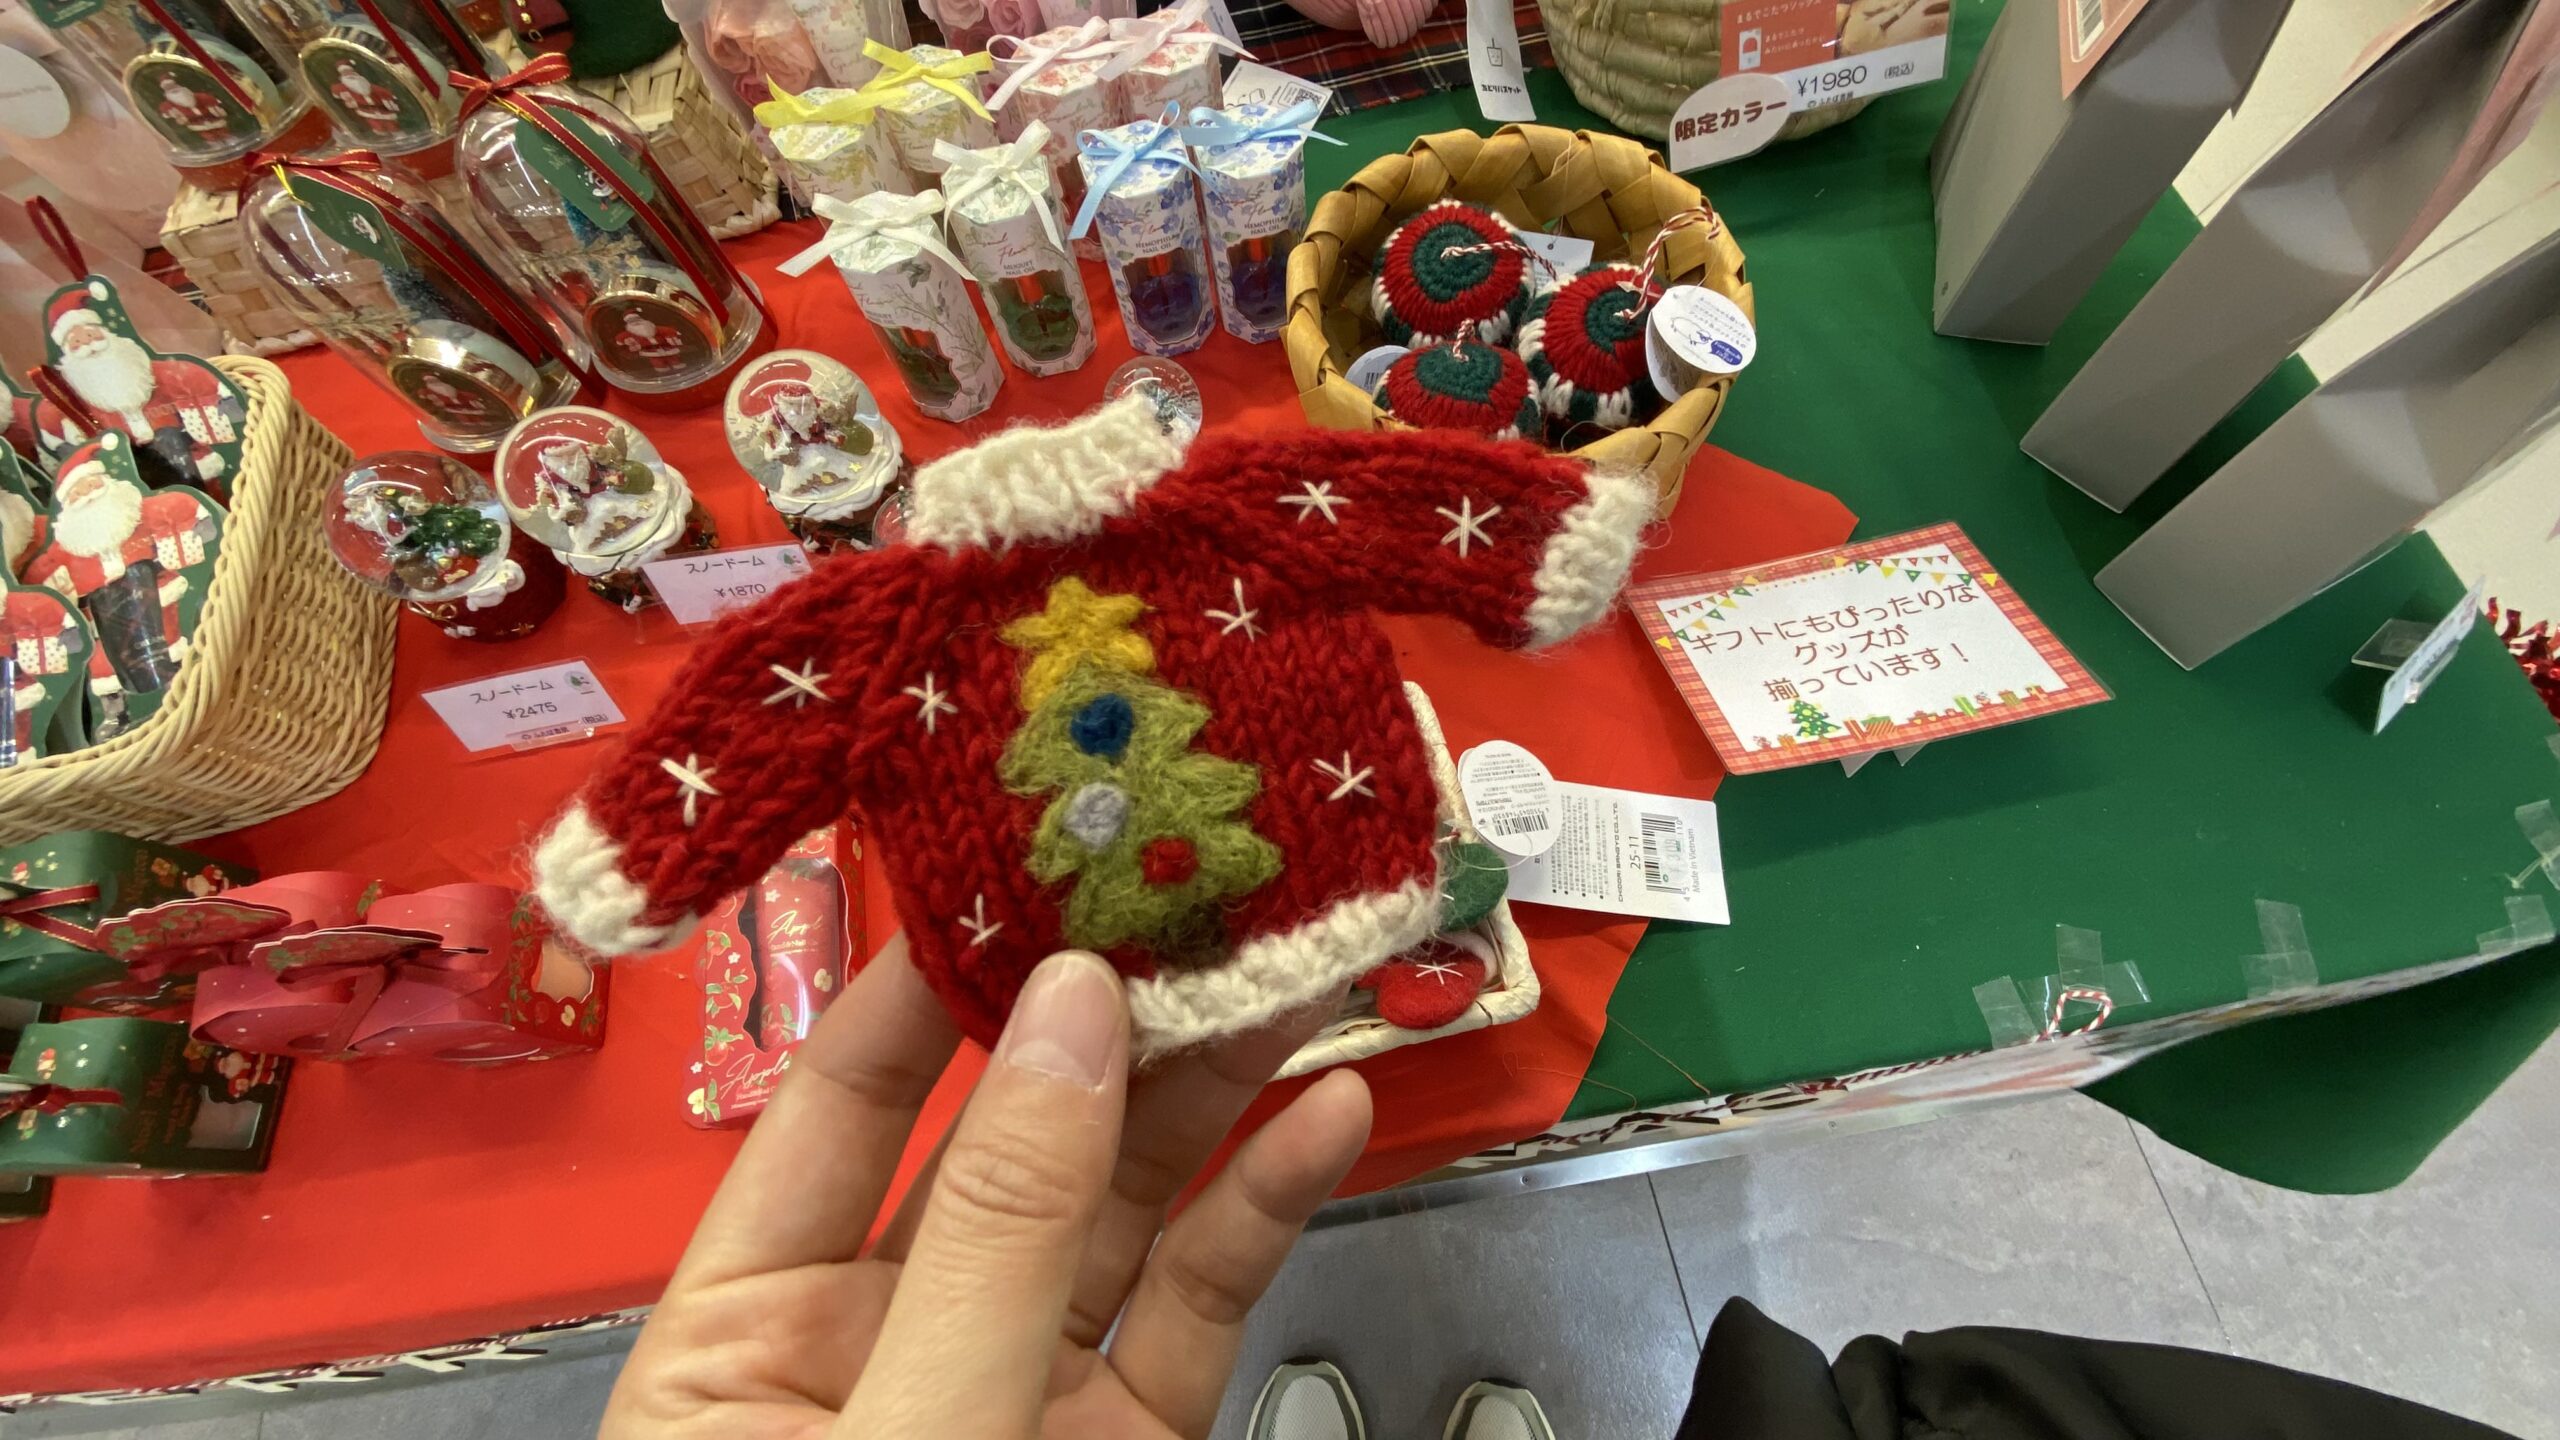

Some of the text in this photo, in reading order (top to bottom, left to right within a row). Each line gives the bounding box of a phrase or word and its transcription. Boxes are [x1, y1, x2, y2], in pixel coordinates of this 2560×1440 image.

[1798, 65, 1867, 97] ¥1980
[1674, 100, 1787, 142] 限定カラー
[684, 555, 765, 574] スノードーム
[713, 583, 766, 598] ¥1870
[1690, 583, 1980, 655] ギフトにもぴったりな
[1793, 624, 1910, 665] グッズが
[470, 680, 555, 704] スノードーム
[502, 701, 558, 720] ¥2475
[1628, 835, 1641, 870] 25-11
[1688, 828, 1697, 860] Vietnam
[1692, 873, 1700, 893] Made
[720, 1050, 791, 1100] Apple
